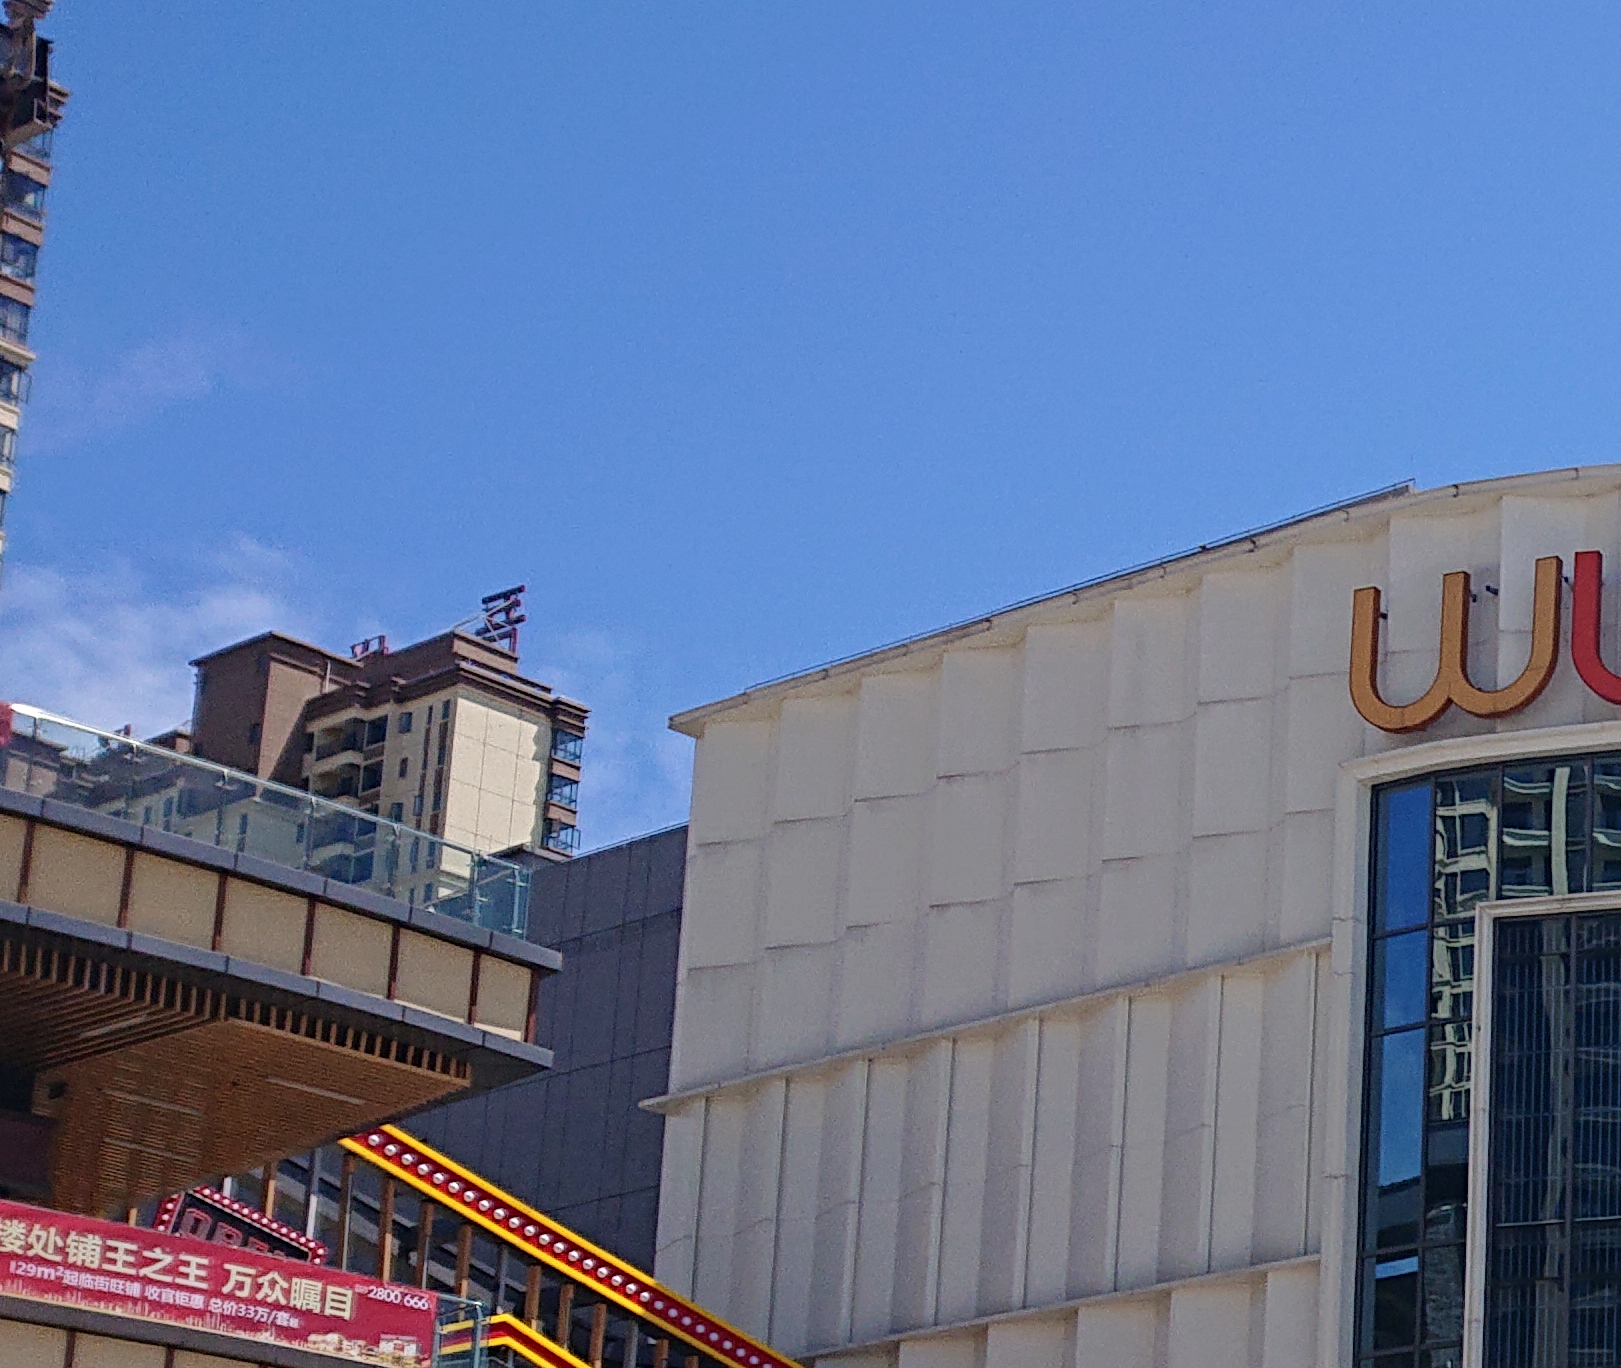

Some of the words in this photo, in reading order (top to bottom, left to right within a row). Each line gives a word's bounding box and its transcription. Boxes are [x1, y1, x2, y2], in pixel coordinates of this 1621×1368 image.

[221, 1263, 353, 1321] 万众瞩目
[367, 1285, 402, 1304] 2800
[403, 1296, 429, 1311] 666
